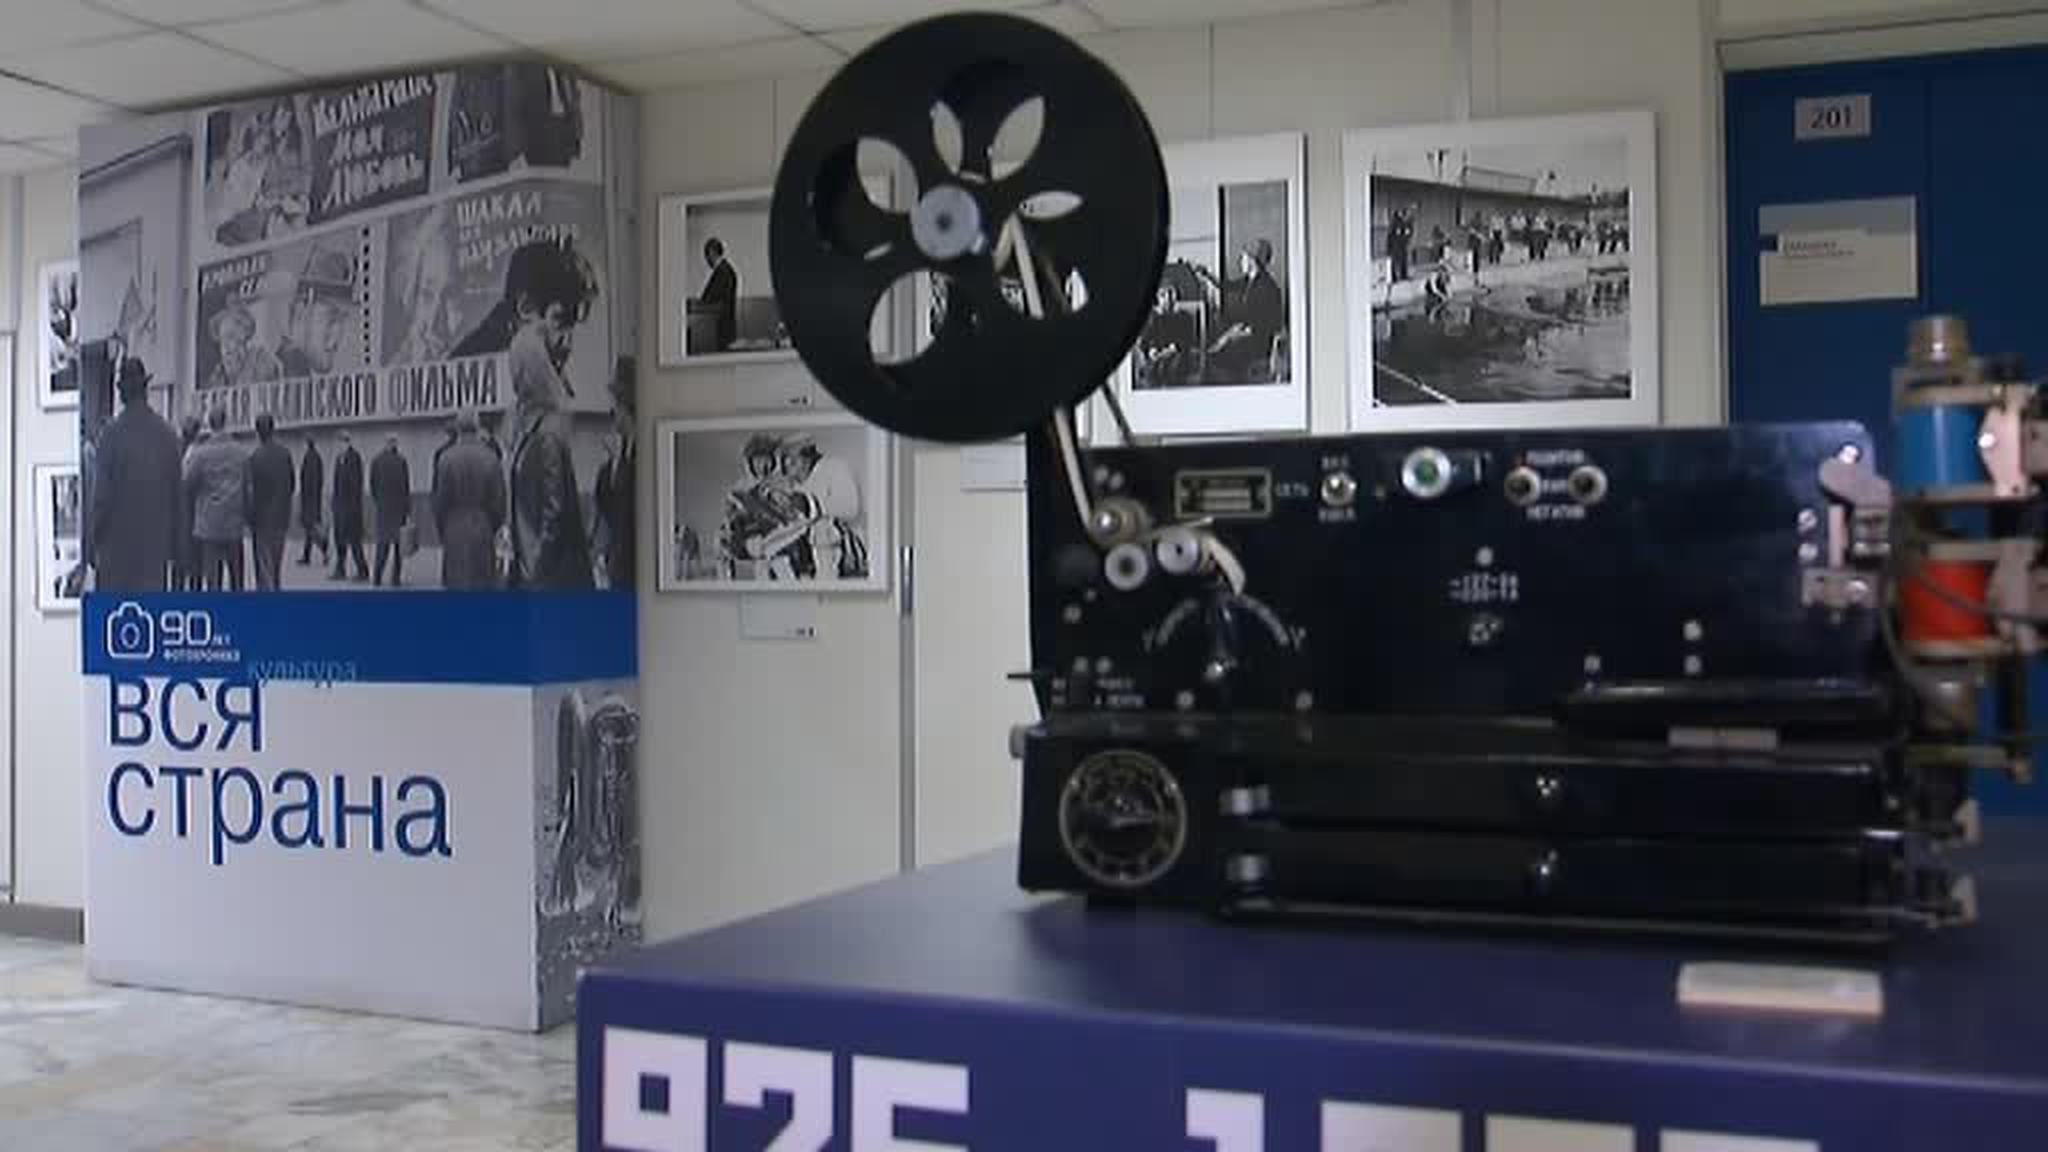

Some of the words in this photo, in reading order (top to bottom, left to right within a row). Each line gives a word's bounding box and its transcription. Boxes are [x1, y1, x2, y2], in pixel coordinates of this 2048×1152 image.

[1811, 105, 1853, 130] 201
[160, 610, 212, 646] 90
[107, 760, 452, 865] страна
